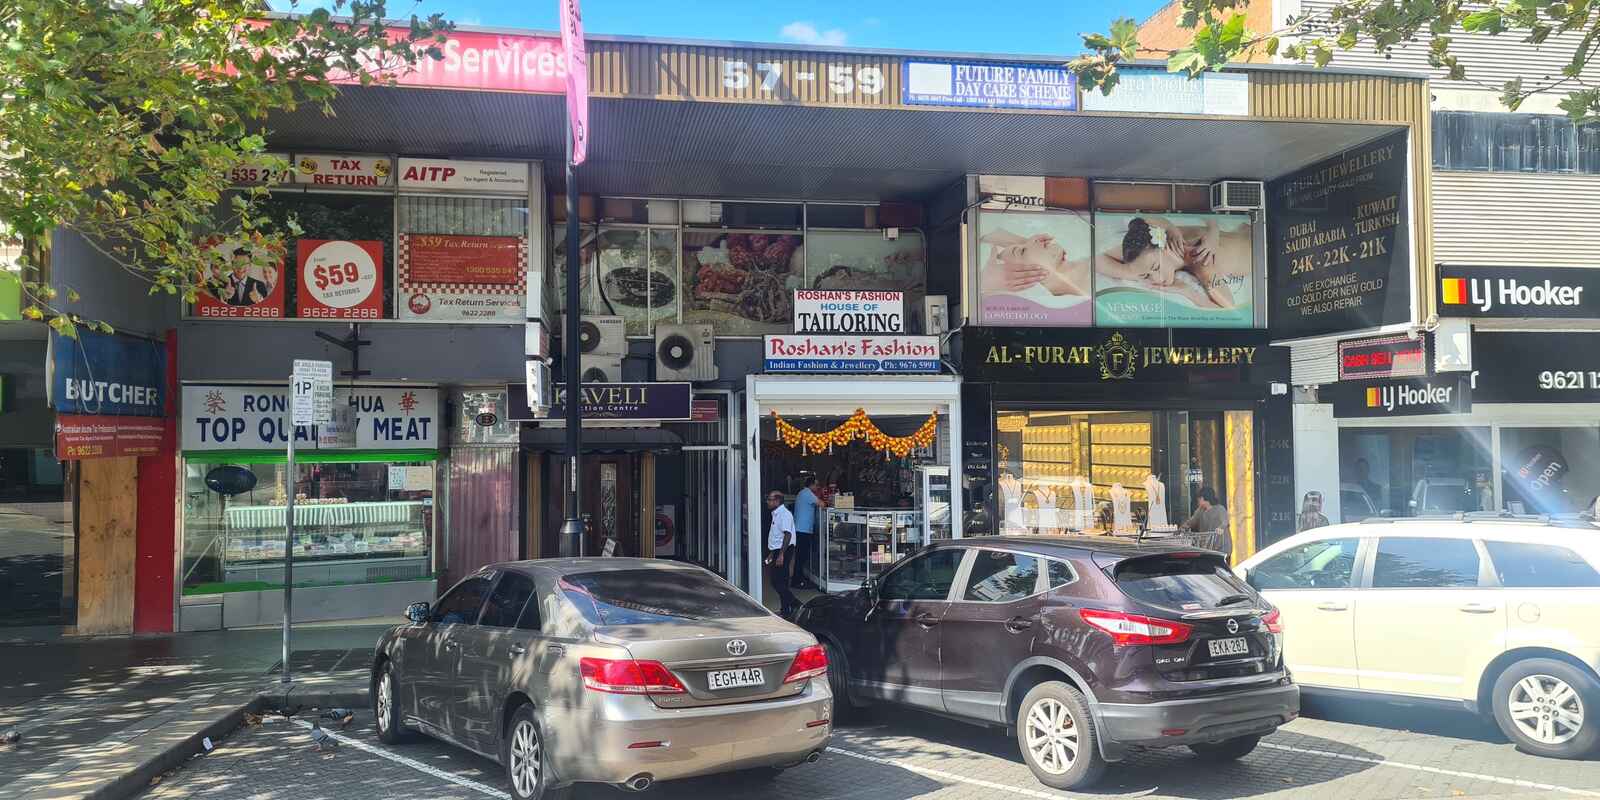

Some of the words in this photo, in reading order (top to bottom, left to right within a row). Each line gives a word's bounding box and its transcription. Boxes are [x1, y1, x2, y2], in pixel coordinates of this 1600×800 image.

[444, 39, 568, 78] Services
[955, 64, 1014, 82] FUTURE
[1018, 67, 1072, 85] FAMILY
[956, 81, 982, 96] DAY
[983, 82, 1017, 97] CARE
[1019, 84, 1072, 99] SCHEME
[330, 159, 361, 171] TAX
[1328, 144, 1395, 182] JEWELLERY
[231, 169, 257, 182] 535
[313, 174, 378, 185] RETURN
[403, 166, 456, 182] AITP
[1358, 196, 1397, 219] KUWAIT
[1289, 220, 1316, 238] DUBAI
[1355, 211, 1400, 235] TURKISH
[1286, 237, 1312, 255] SAUDI
[1313, 226, 1346, 247] ARABIA
[1291, 254, 1314, 275] 24K
[1323, 245, 1351, 268] 22K
[1360, 236, 1387, 259] 21K
[313, 262, 360, 290] $59
[1303, 281, 1314, 292] WE
[1315, 272, 1357, 290] EXCHANGE
[797, 291, 851, 301] ROSHAN'S
[855, 292, 900, 301] FASHION
[1287, 296, 1301, 307] OLD
[1302, 292, 1322, 305] GOLD
[1323, 288, 1339, 301] FOR
[1340, 284, 1359, 296] NEW
[1361, 278, 1383, 292] GOLD
[1471, 278, 1492, 312] LJ
[1499, 278, 1584, 306] Hooker
[201, 306, 237, 317] 9622
[243, 306, 279, 317] 2288
[303, 307, 337, 318] 9622
[343, 308, 378, 318] 2288
[820, 303, 859, 311] HOUSE
[863, 303, 880, 311] OF
[1106, 303, 1162, 315] MASSAGE
[1301, 305, 1312, 316] WE
[1313, 300, 1333, 314] ALSO
[1334, 296, 1362, 310] REPAIR
[798, 313, 901, 332] TAILORING
[770, 338, 856, 356] Roshan's
[860, 339, 936, 356] Fashion
[769, 361, 796, 369] Indian
[798, 361, 829, 369] Fashion
[830, 361, 838, 369] &
[839, 361, 877, 371] Jewellery
[884, 361, 897, 369] Ph:
[899, 361, 918, 369] 9676
[919, 361, 937, 369] 5991
[985, 346, 1092, 365] AL-FURAT
[1143, 347, 1257, 368] JEWELLERY
[295, 382, 312, 395] 1P
[1540, 371, 1585, 389] 9621
[65, 378, 158, 406] BUTCHER
[1382, 385, 1395, 412] LJ
[1398, 383, 1452, 406] Hooker
[243, 395, 290, 413] RON
[348, 394, 385, 413] HUA
[398, 391, 419, 416] 華
[196, 417, 246, 443] TOP
[373, 417, 432, 441] MEAT
[1530, 460, 1564, 492] Open
